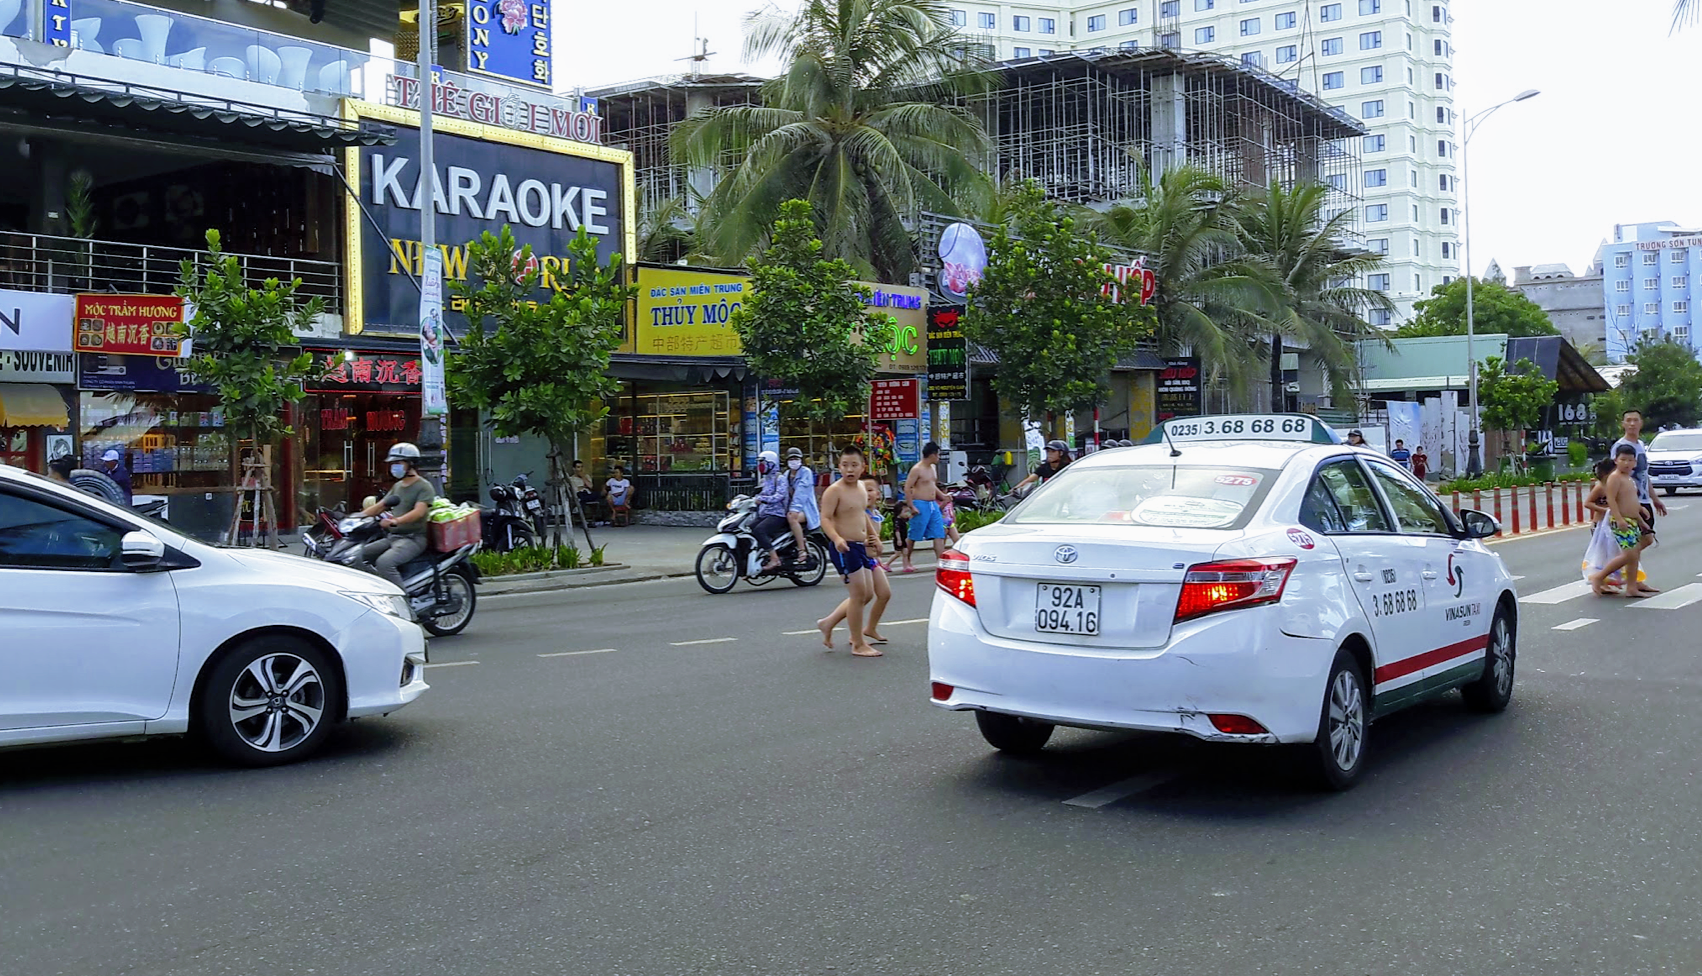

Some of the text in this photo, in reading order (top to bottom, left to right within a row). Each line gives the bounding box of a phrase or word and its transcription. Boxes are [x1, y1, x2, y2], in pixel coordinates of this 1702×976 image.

[472, 0, 490, 69] ONY
[531, 0, 550, 83] 단호화
[372, 154, 609, 234] KARAOKE
[714, 283, 742, 293] TRUNG
[650, 298, 697, 326] THỦY
[14, 352, 73, 372] SOUVENIR
[1558, 403, 1587, 421] 168
[1204, 420, 1244, 435] 3.68
[1251, 419, 1274, 433] 68
[1282, 418, 1305, 433] 68
[1215, 475, 1253, 486] 5275
[1292, 532, 1313, 547] 5275
[1052, 587, 1084, 609] 92A
[1395, 590, 1405, 613] 68
[1407, 589, 1417, 611] 68
[1038, 609, 1097, 633] 094.16
[1445, 604, 1471, 621] VINASUN
